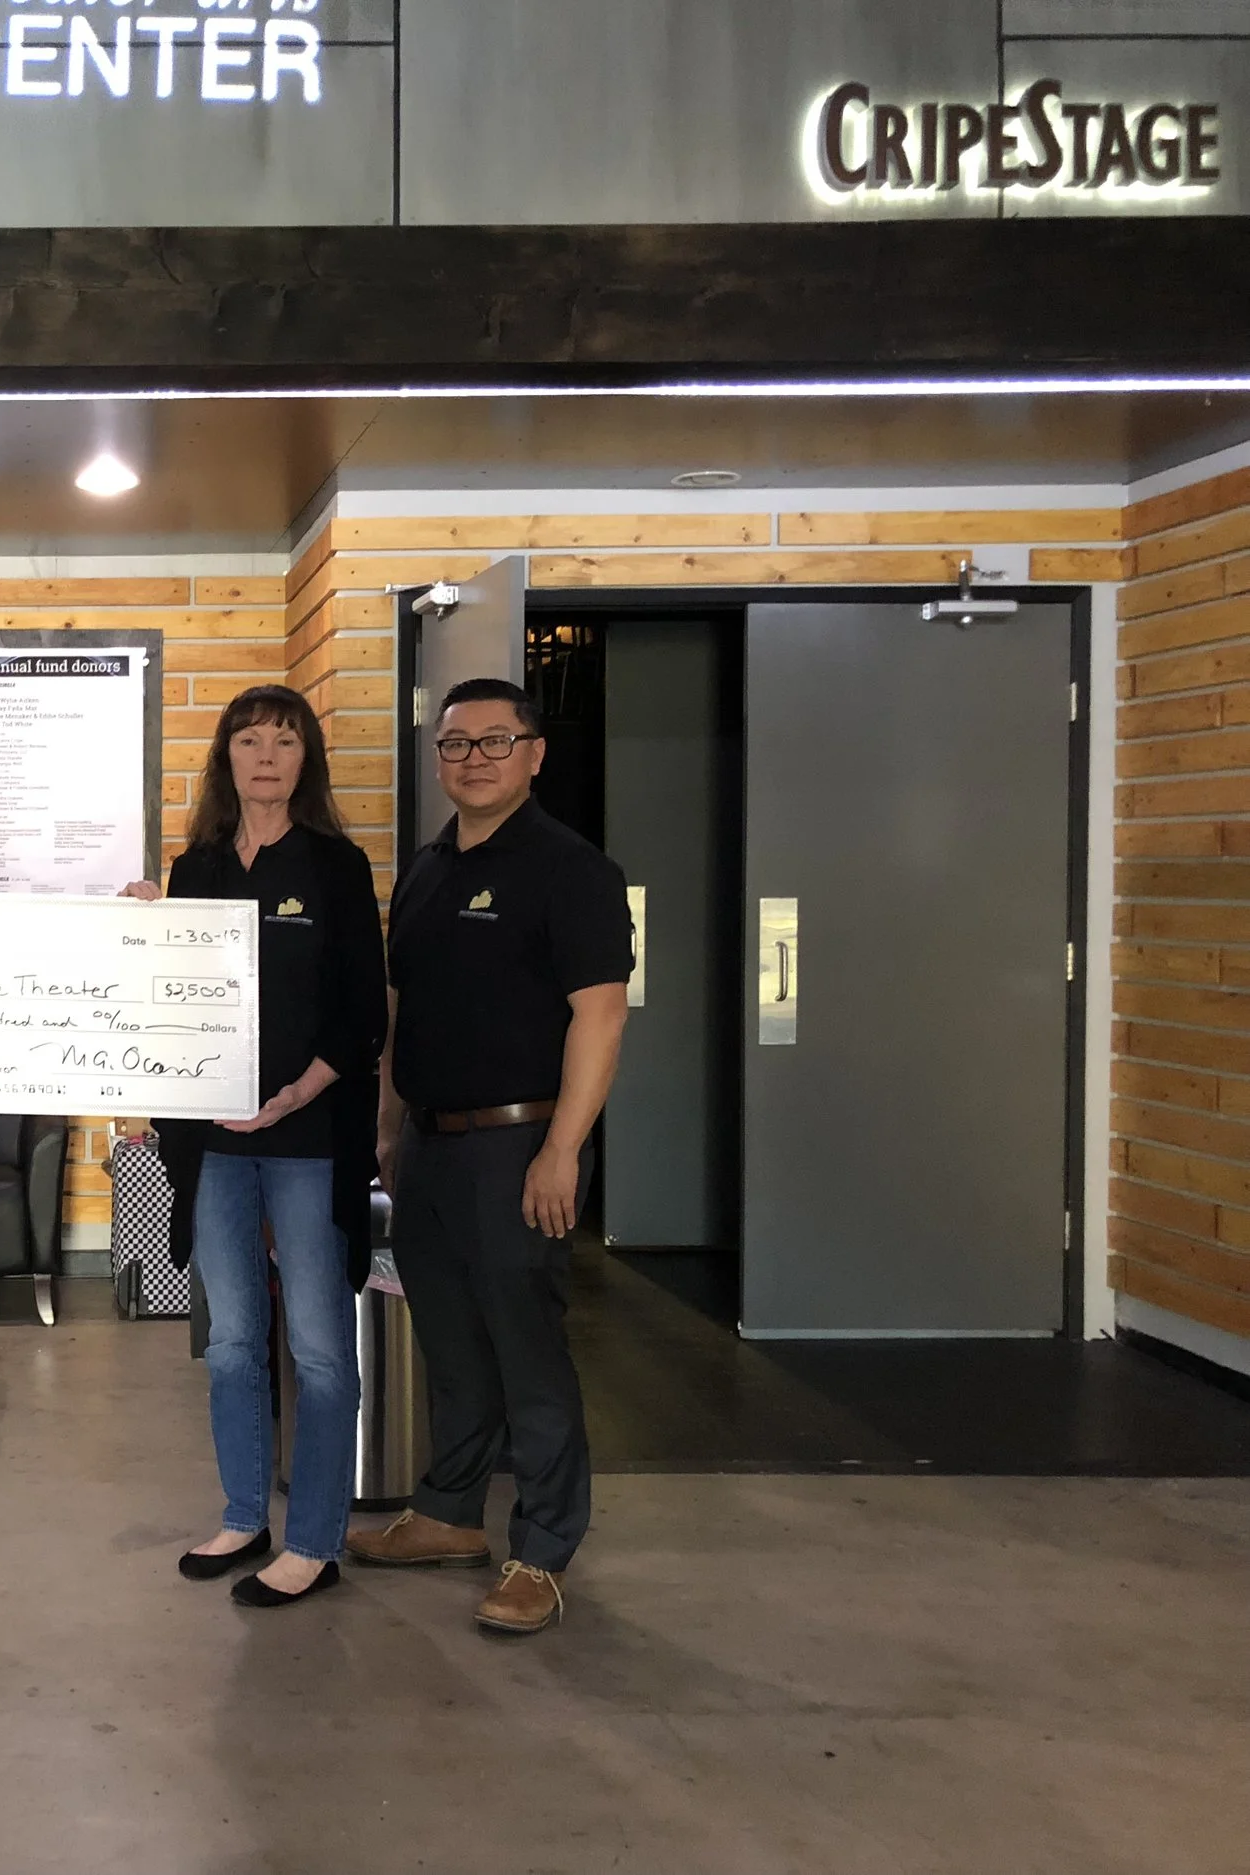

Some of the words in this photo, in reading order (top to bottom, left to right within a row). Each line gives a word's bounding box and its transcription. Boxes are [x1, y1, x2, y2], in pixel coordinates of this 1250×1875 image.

[35, 659, 68, 674] fund
[71, 659, 121, 674] donors
[122, 935, 146, 946] Date
[14, 974, 120, 998] Theater
[42, 1015, 79, 1027] and
[201, 1022, 238, 1034] Dollars
